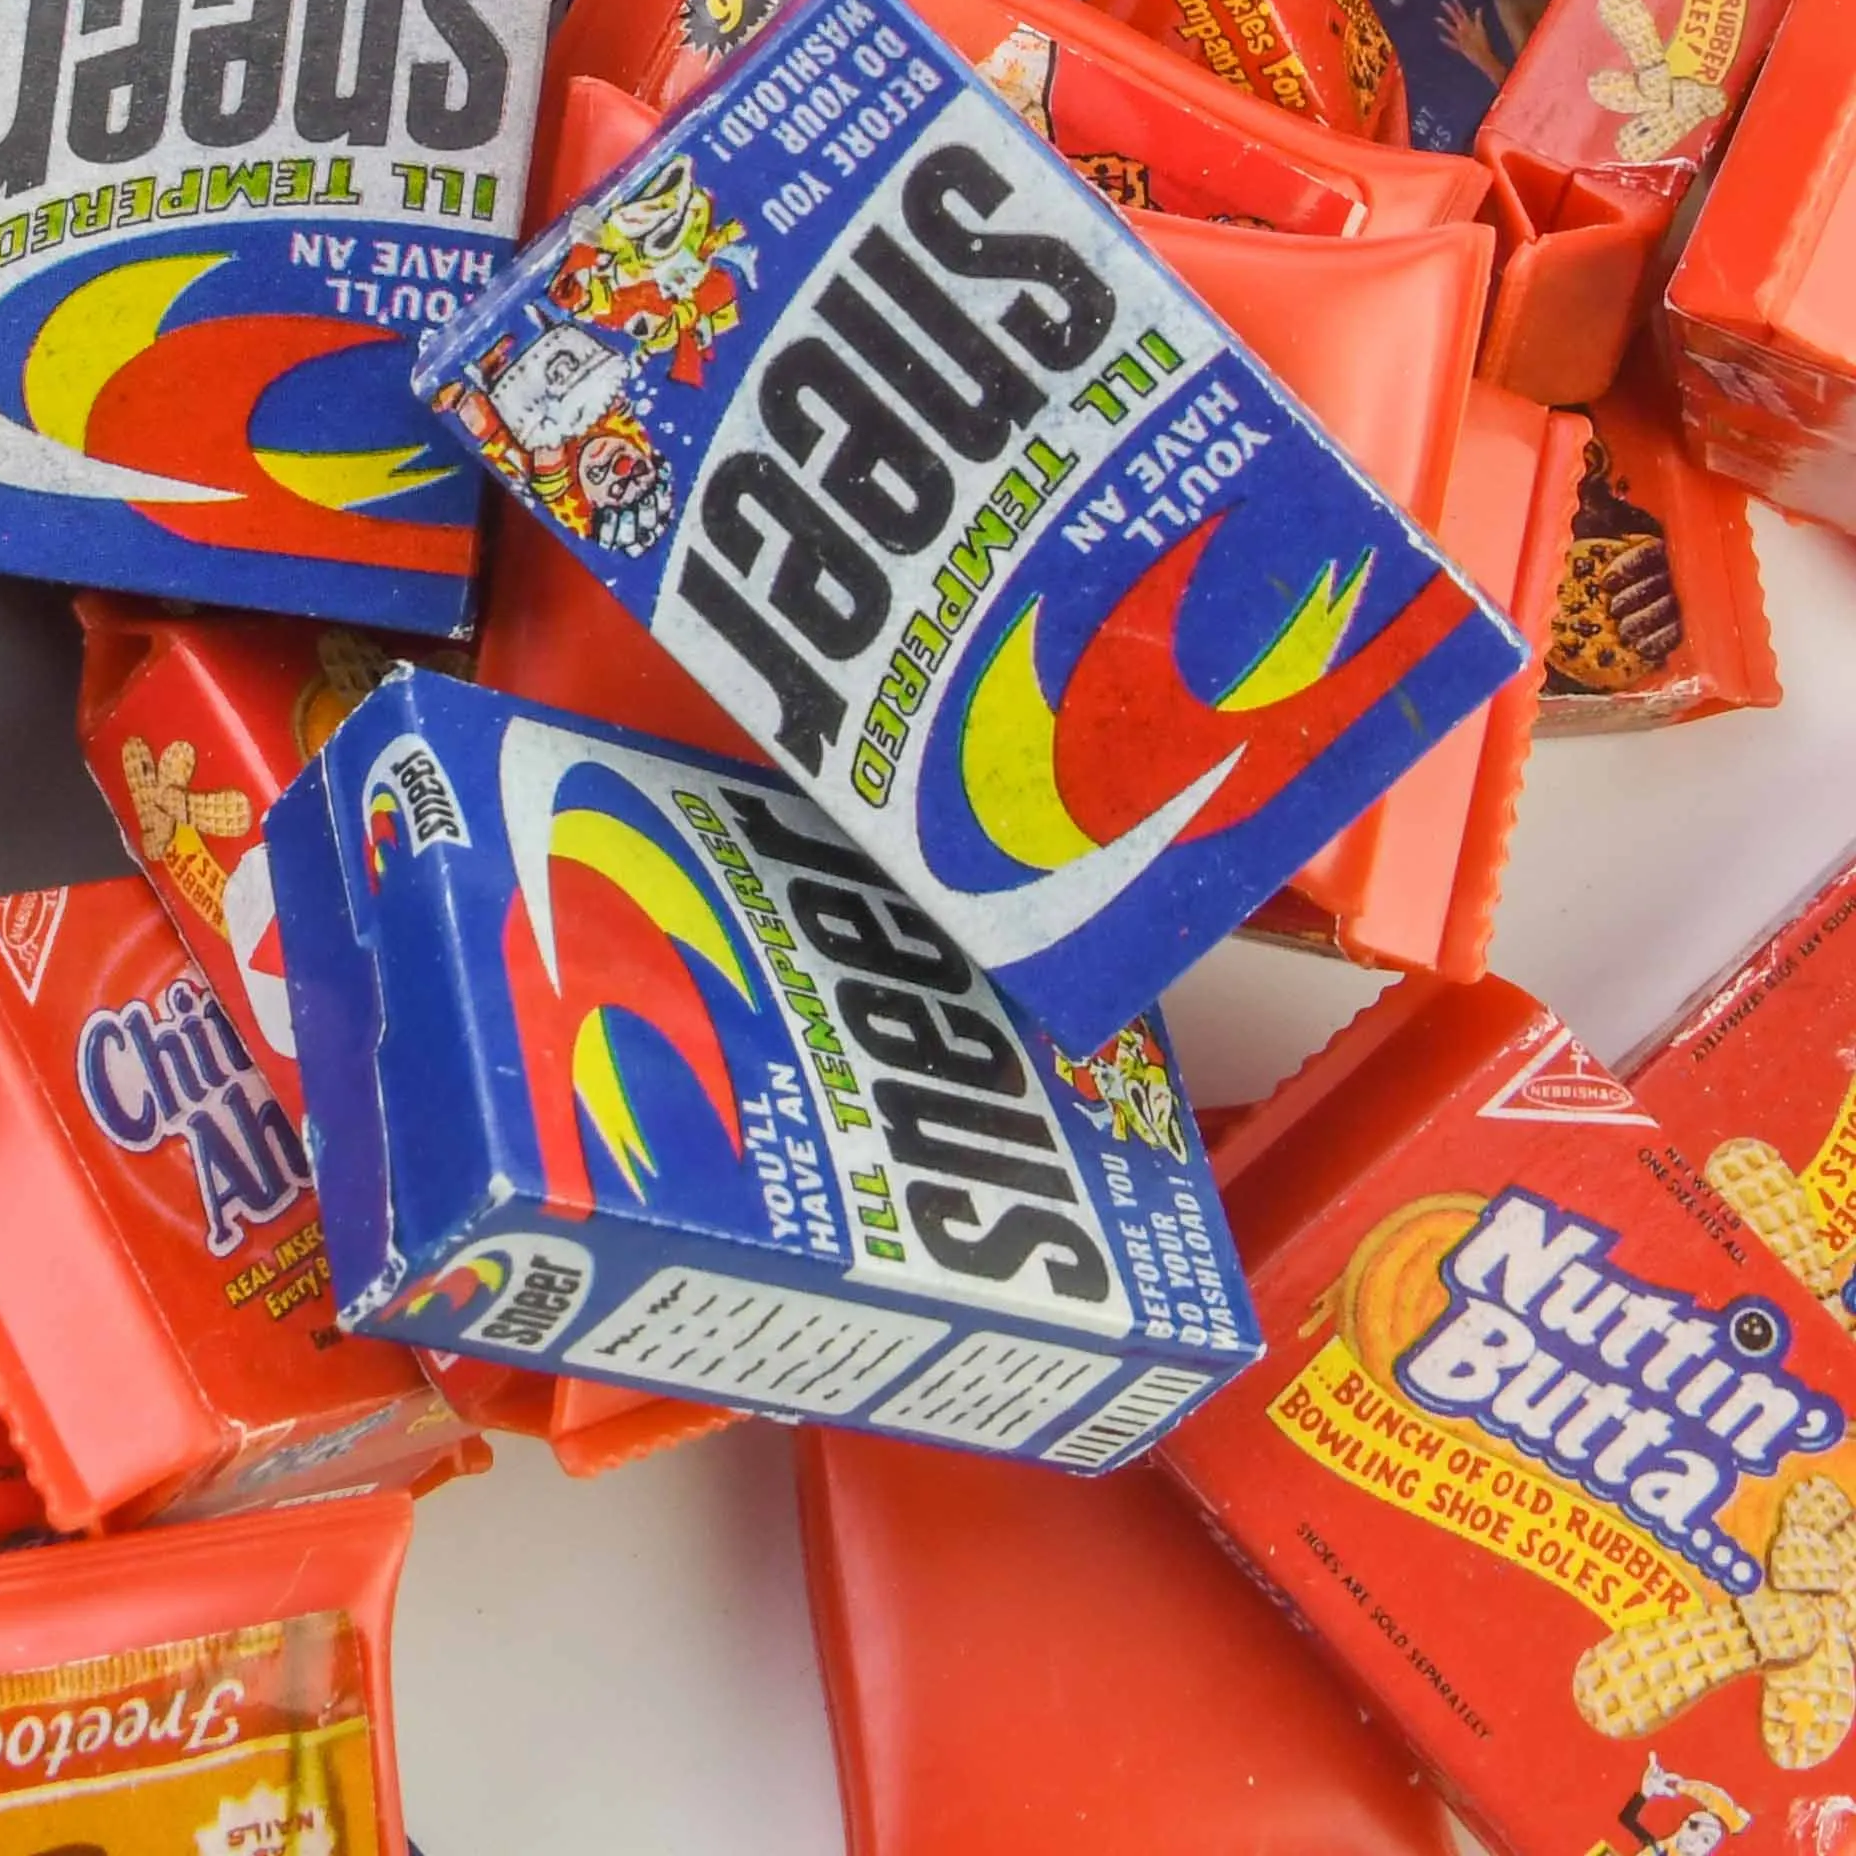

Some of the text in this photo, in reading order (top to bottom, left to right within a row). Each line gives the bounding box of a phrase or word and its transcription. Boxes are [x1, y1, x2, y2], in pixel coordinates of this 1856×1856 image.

[761, 60, 945, 236] BEFORE YOU
[778, 26, 909, 156] DO YOUR
[1261, 54, 1308, 112] For
[289, 230, 495, 289] HAVE AN
[391, 160, 500, 222] ILL
[677, 140, 1118, 778] sneer
[1061, 381, 1240, 555] HAVE AN
[1122, 420, 1272, 547] YOU'LL
[849, 329, 1181, 810] ILL TEMPERED
[390, 748, 461, 845] sneer
[671, 790, 873, 1134] TEMPERED
[742, 1091, 797, 1241] YOU'LL
[765, 1062, 841, 1255] HAVE AN
[850, 1163, 907, 1264] ILL
[1636, 1146, 1668, 1184] ONE
[225, 1261, 276, 1306] REAL
[263, 1266, 320, 1321] Every
[480, 1254, 589, 1351] sneer
[1101, 1152, 1172, 1341] BEFORE YOU
[1154, 1208, 1193, 1292] YOUR
[1169, 1173, 1240, 1351] WASHLOAD!
[1450, 1196, 1830, 1462] Nuttin'
[1278, 1384, 1513, 1543] BOWLING SHOE
[1446, 1446, 1692, 1620] OF RUBBER
